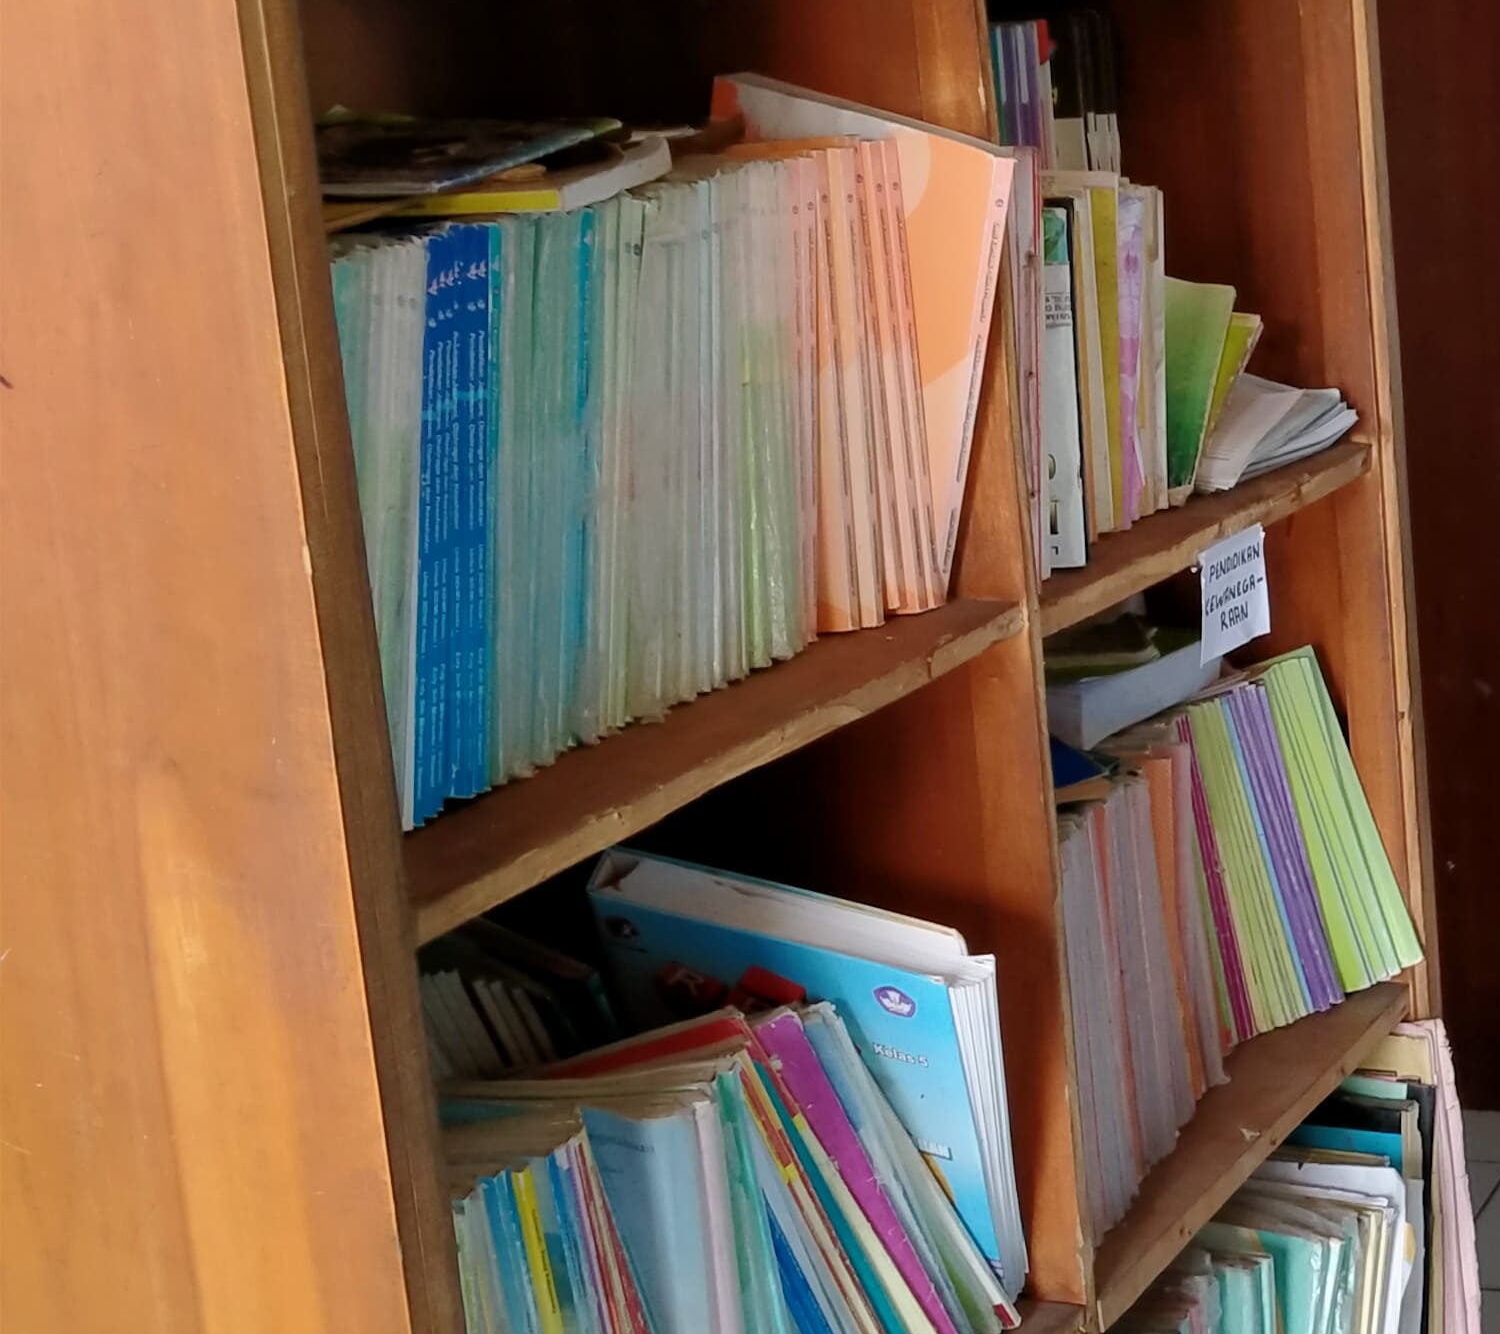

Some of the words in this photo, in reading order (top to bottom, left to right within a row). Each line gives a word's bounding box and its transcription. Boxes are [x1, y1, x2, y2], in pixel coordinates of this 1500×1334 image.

[1209, 542, 1260, 584] PENDIDIKAN
[1205, 574, 1263, 616] KEWANEGA-
[1220, 601, 1248, 632] RAAN
[872, 1042, 916, 1065] Kelas
[917, 1055, 929, 1068] 5
